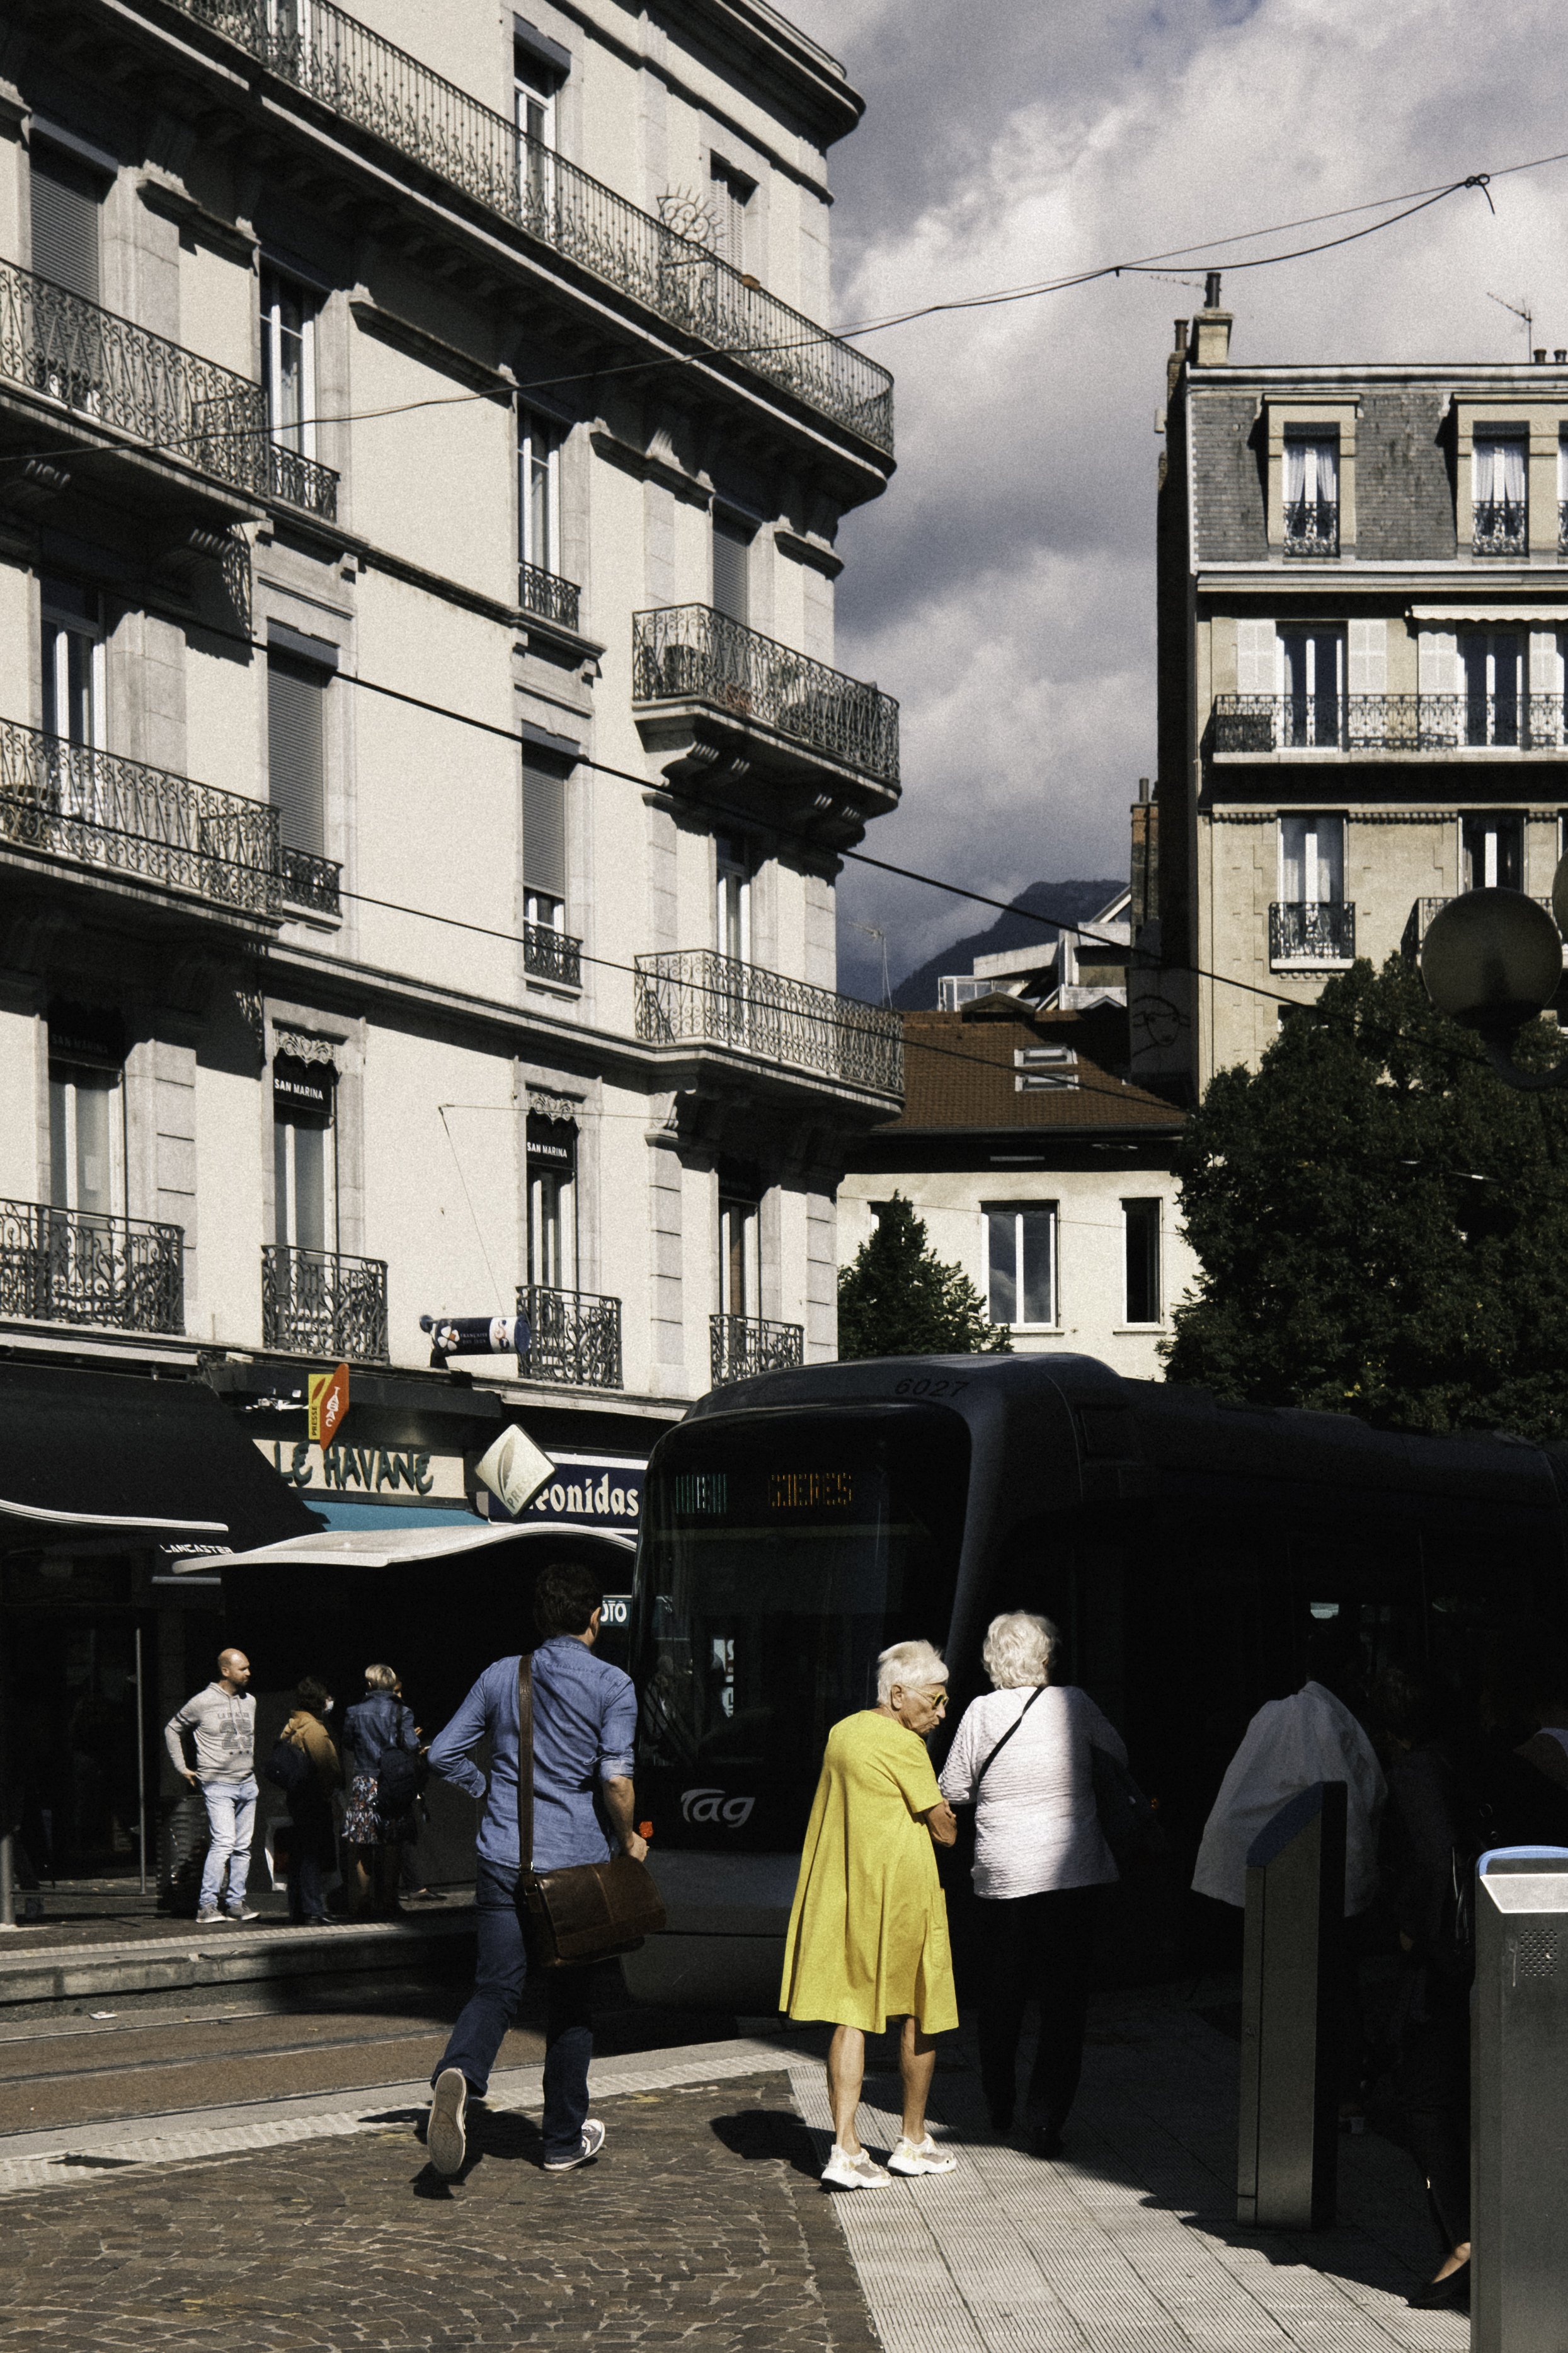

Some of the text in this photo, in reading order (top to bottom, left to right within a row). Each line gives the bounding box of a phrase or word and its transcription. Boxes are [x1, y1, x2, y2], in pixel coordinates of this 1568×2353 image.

[274, 1078, 324, 1100] SAN MARINA
[527, 1141, 568, 1158] SAN MARINA
[894, 1377, 971, 1398] 6027
[325, 1386, 341, 1428] TABAC
[273, 1440, 435, 1496] LE HAVANE
[529, 1473, 639, 1517] eonidas
[159, 1543, 234, 1555] LANCASTER
